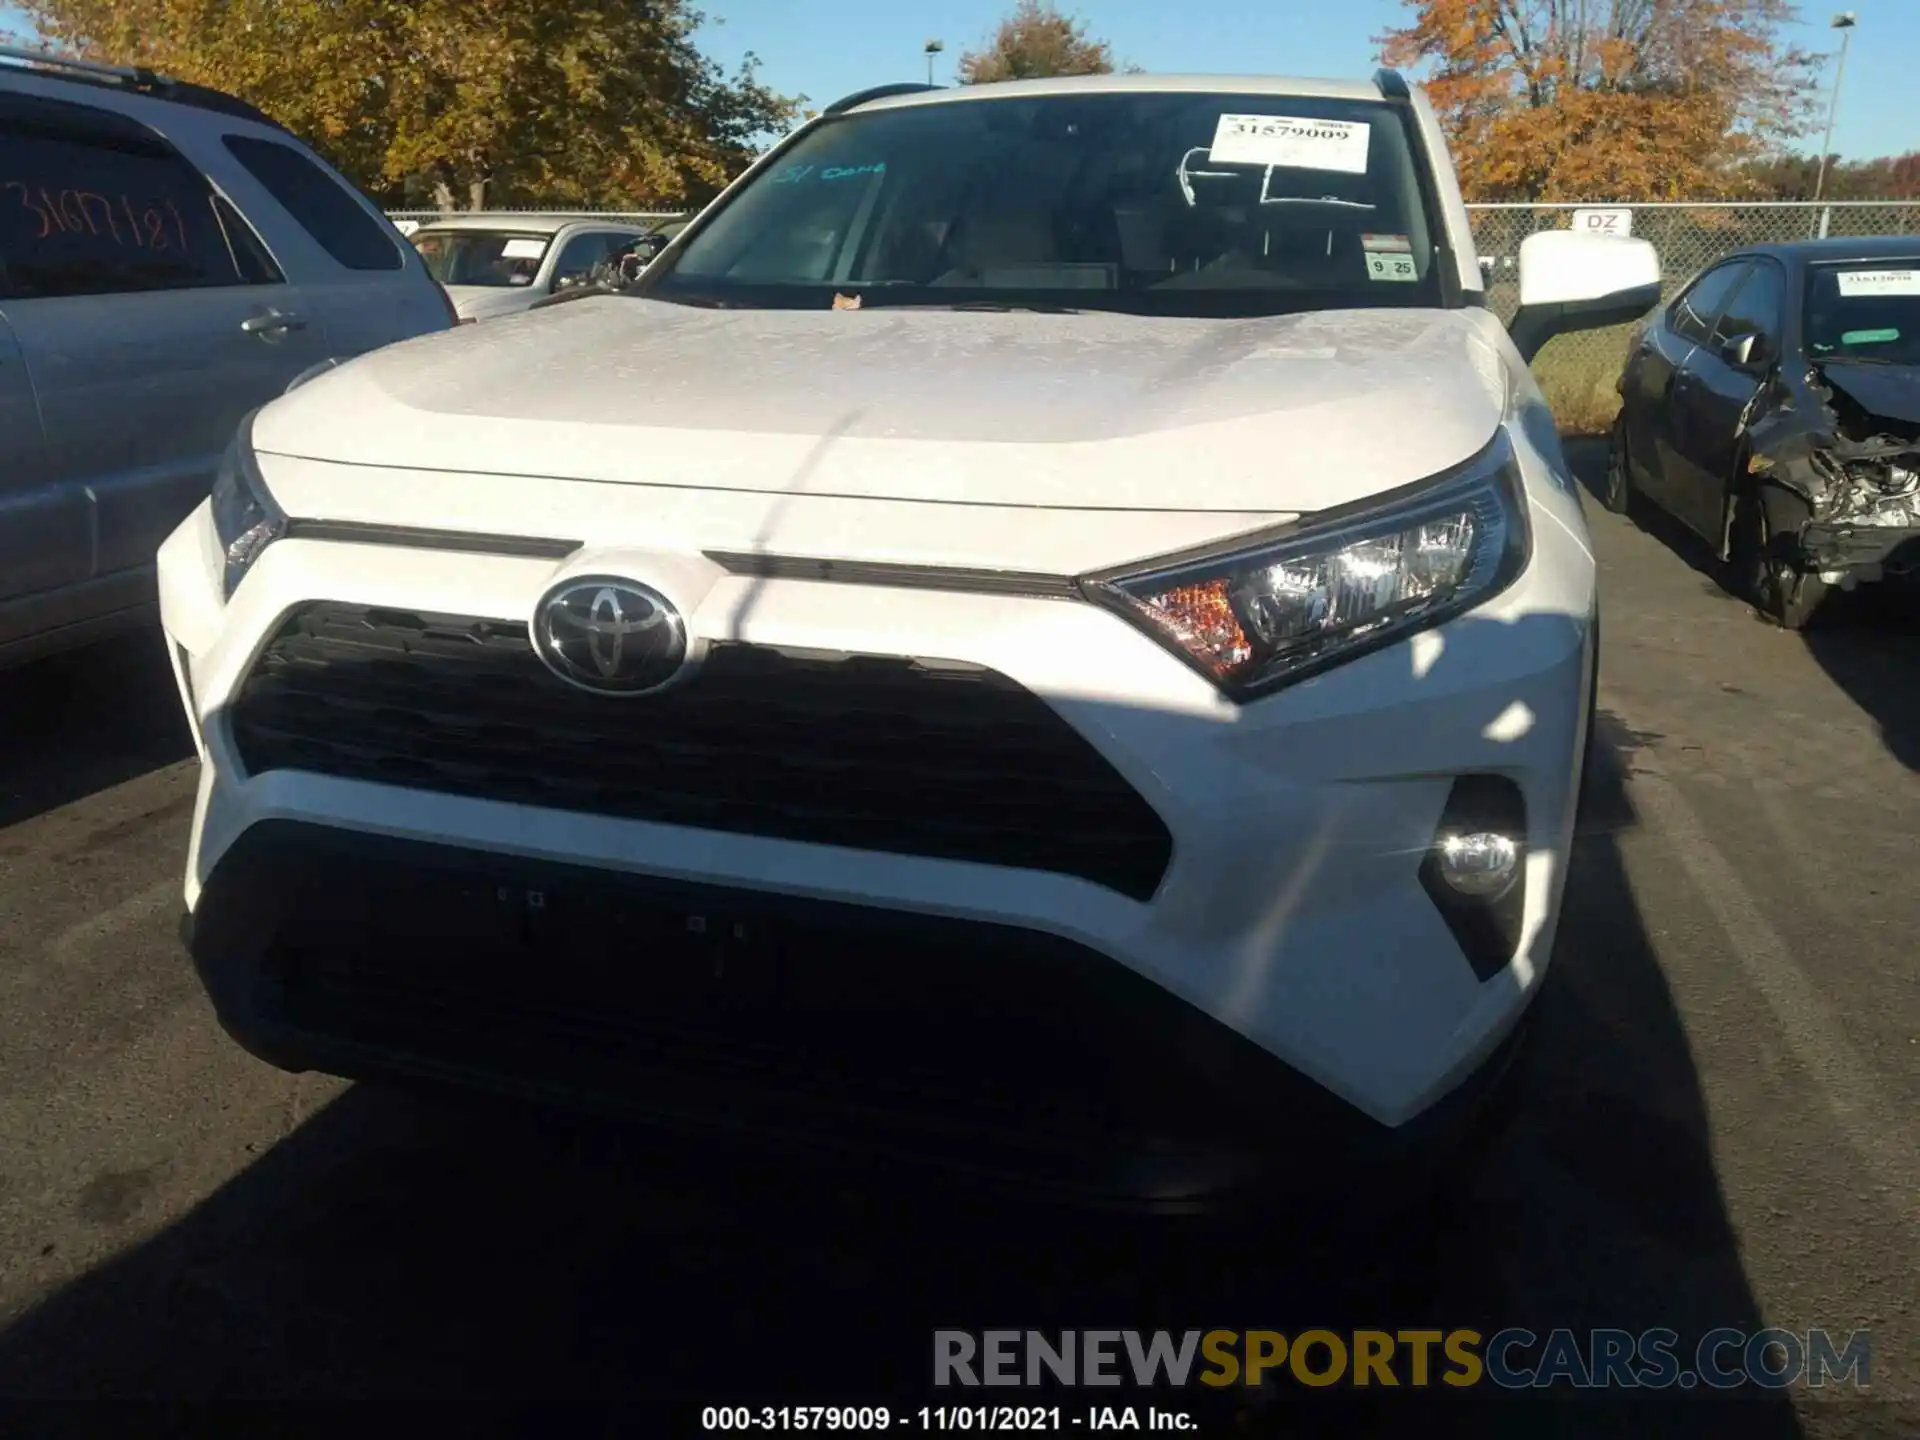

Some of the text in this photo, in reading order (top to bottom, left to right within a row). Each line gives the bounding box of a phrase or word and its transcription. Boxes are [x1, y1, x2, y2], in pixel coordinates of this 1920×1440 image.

[1231, 123, 1350, 141] 31579009
[1587, 214, 1618, 229] DZ
[1373, 260, 1411, 274] 9 25
